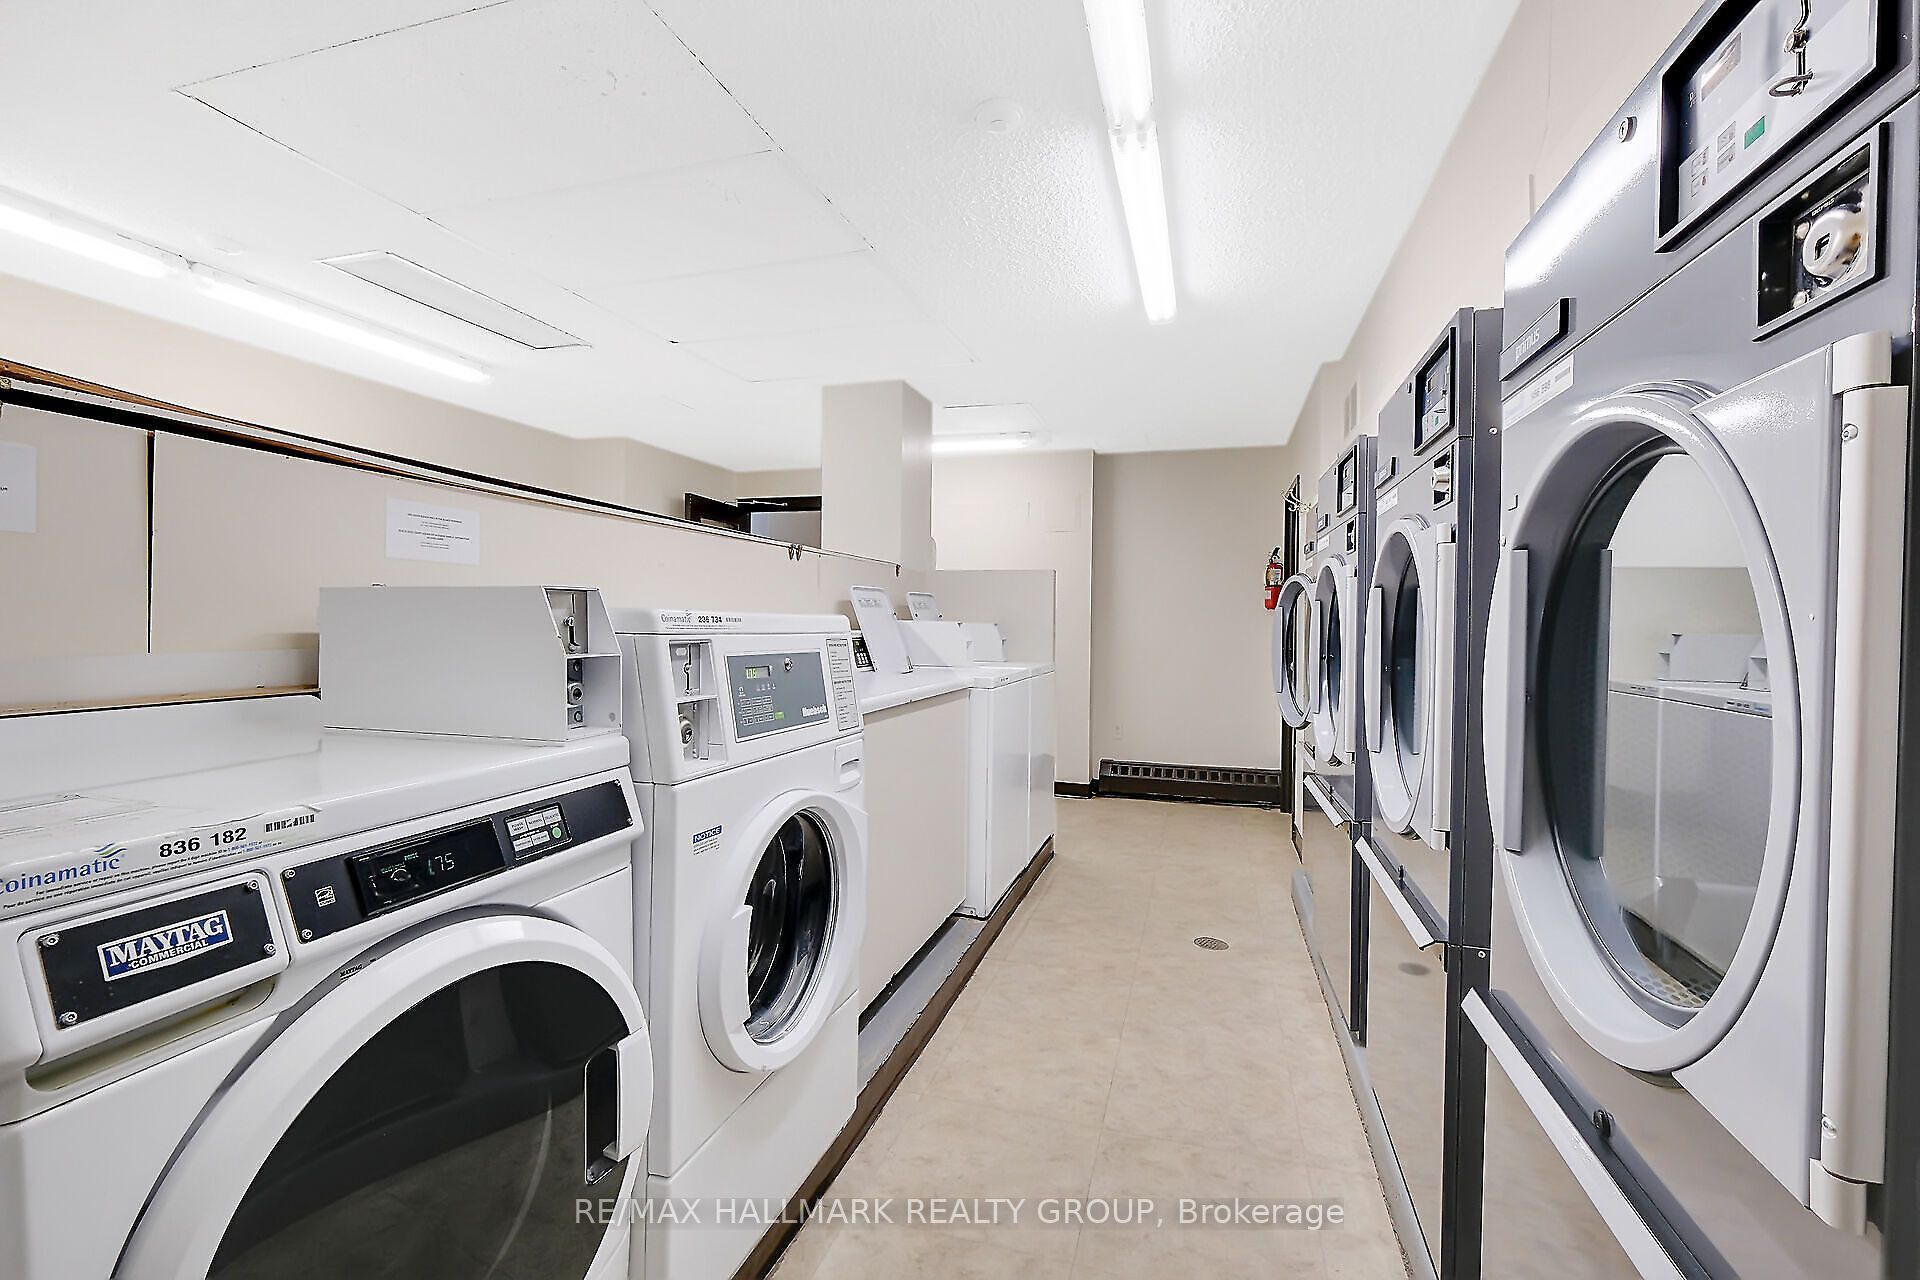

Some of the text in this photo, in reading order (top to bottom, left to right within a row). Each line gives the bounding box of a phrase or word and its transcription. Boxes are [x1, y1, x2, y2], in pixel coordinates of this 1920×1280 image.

[694, 828, 721, 842] NOTICE
[0, 857, 120, 895] oinamatic
[159, 837, 201, 858] 836
[210, 827, 247, 846] 182
[106, 917, 223, 967] MAYTAG
